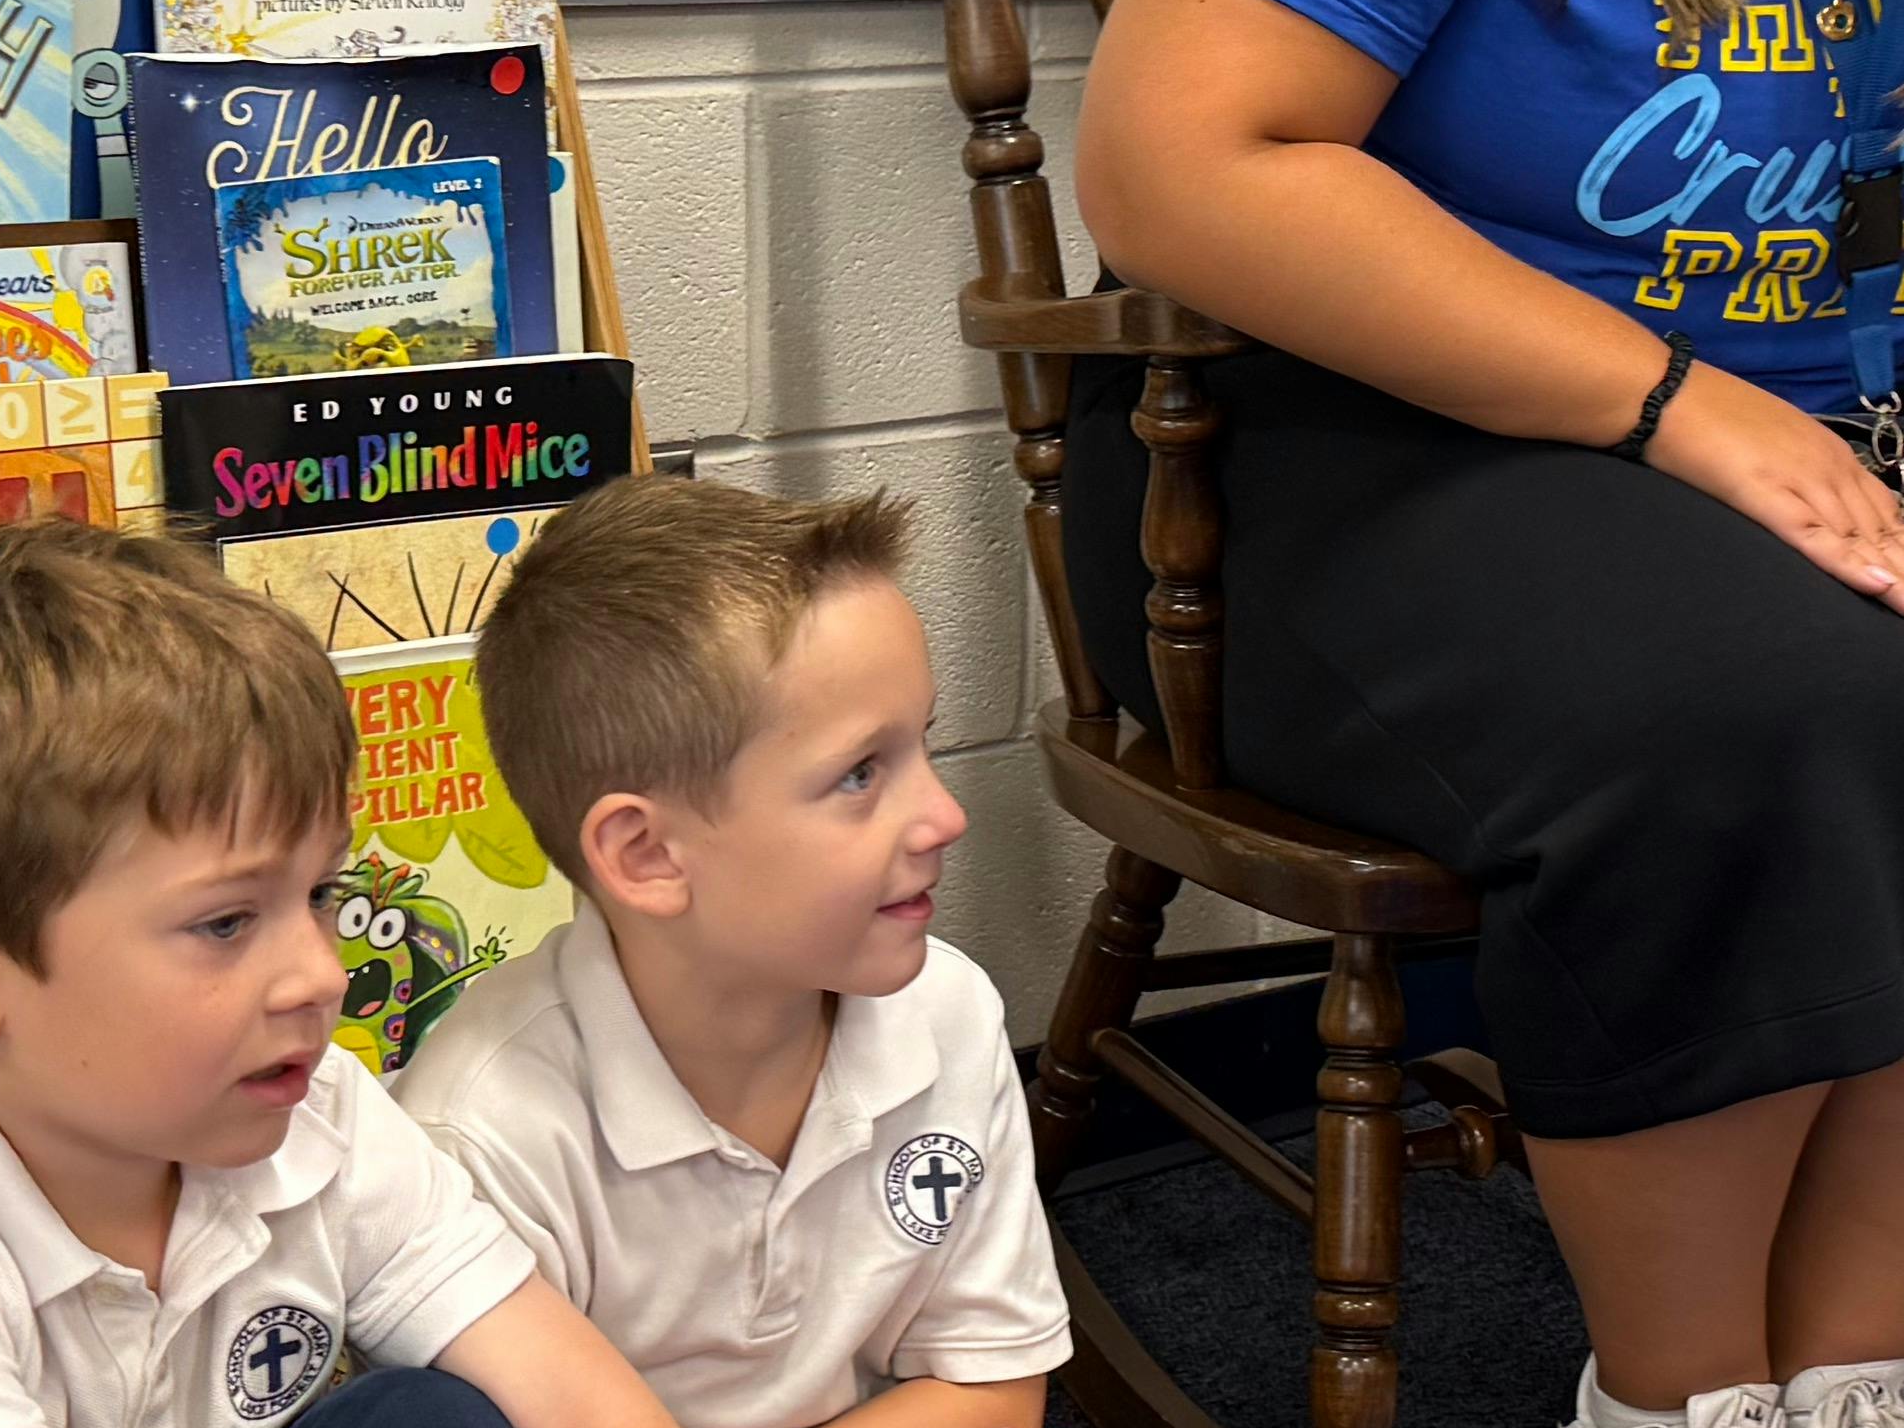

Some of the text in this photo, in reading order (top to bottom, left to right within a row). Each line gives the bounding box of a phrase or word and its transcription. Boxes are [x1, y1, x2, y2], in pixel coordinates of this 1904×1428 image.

[206, 85, 449, 188] Hello
[432, 179, 471, 194] LEVEL
[310, 301, 366, 316] WELCOME
[406, 291, 438, 305] OGRE
[293, 386, 514, 422] ED YOUNG
[212, 420, 592, 520] Seven Blind Mice
[887, 1147, 919, 1206] SCHOOL
[920, 1137, 941, 1150] OF
